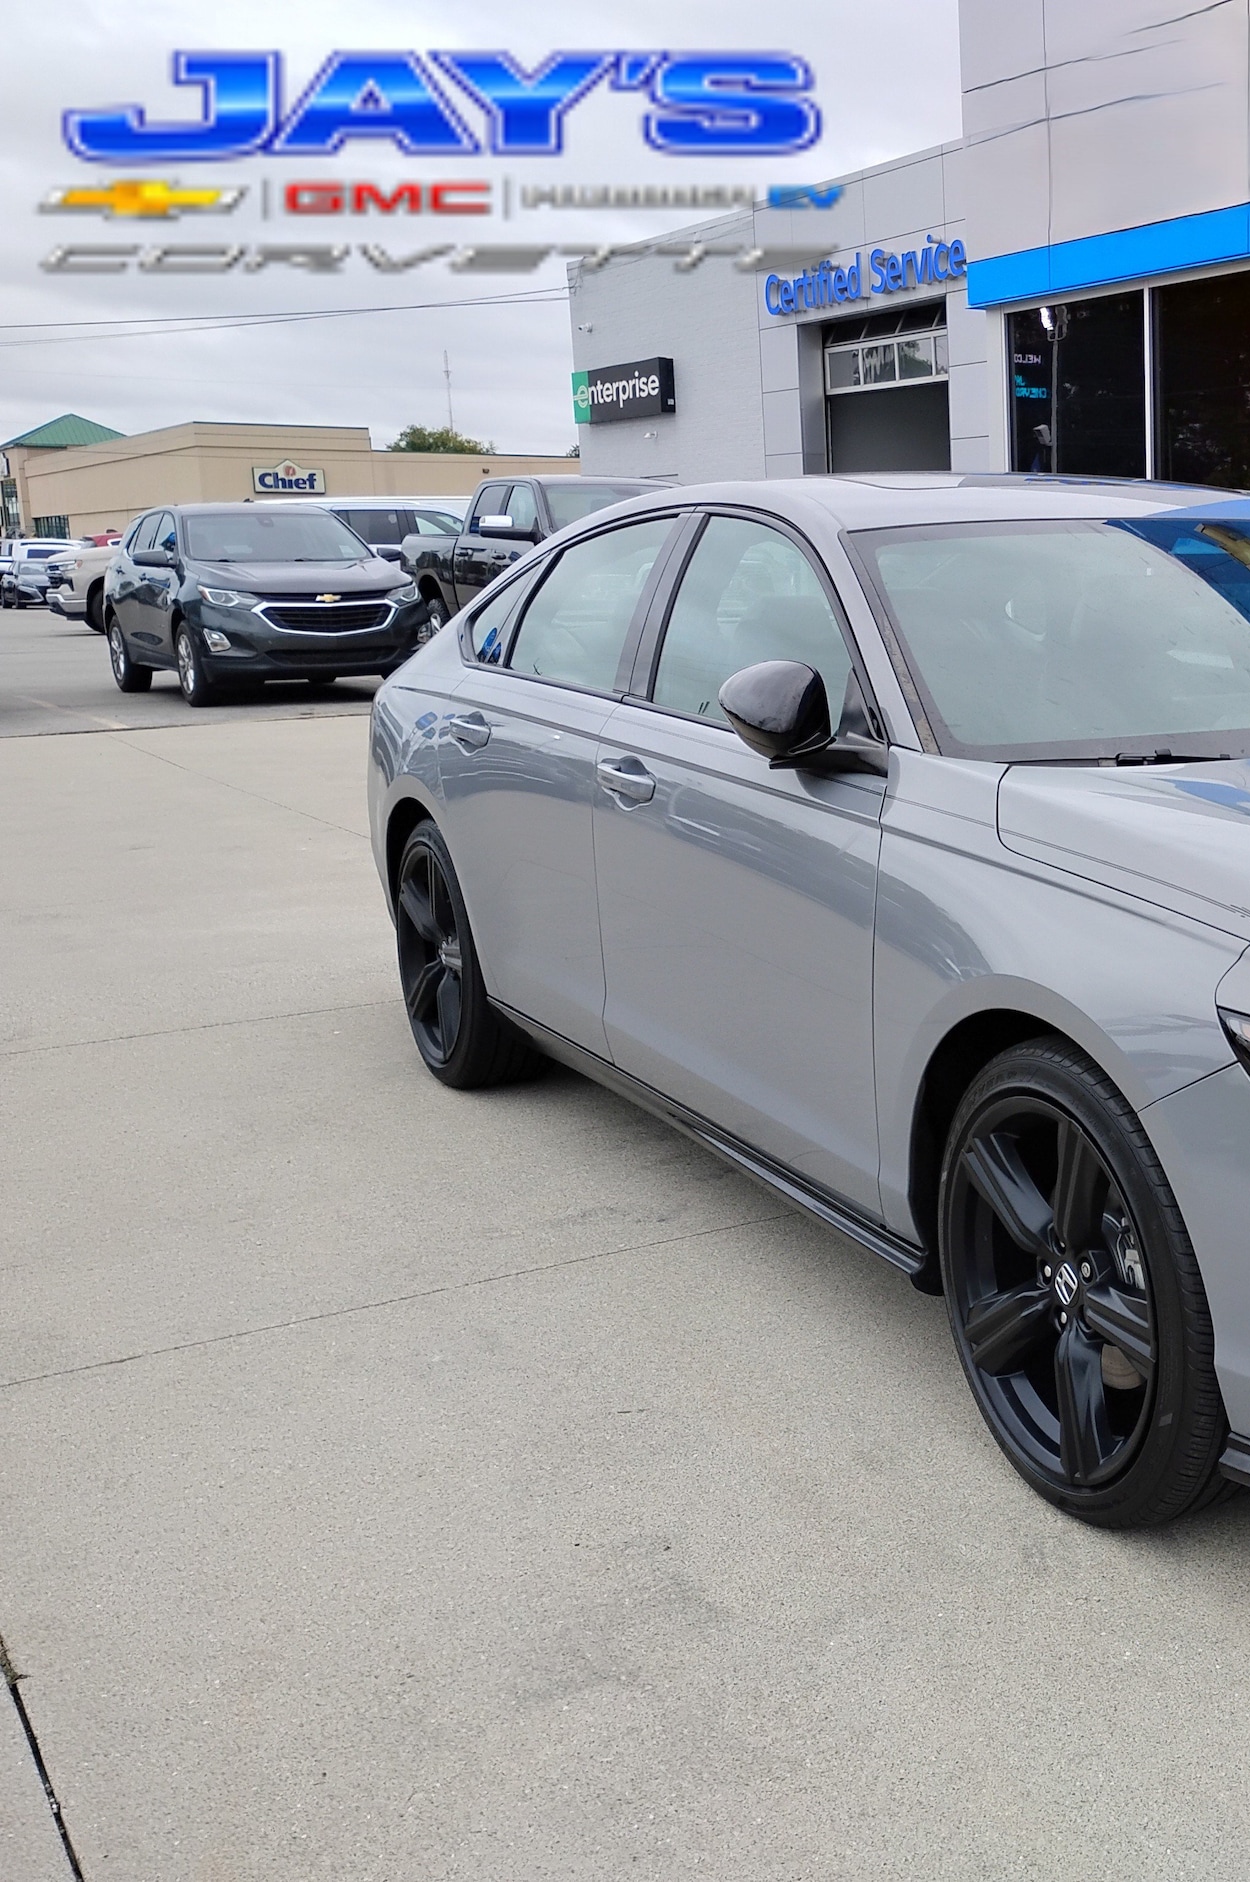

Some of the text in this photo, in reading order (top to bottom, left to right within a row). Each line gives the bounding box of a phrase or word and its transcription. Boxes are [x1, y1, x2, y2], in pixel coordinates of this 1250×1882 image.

[765, 234, 967, 316] Certified Service
[573, 370, 660, 409] enterprise
[258, 472, 317, 490] Chief
